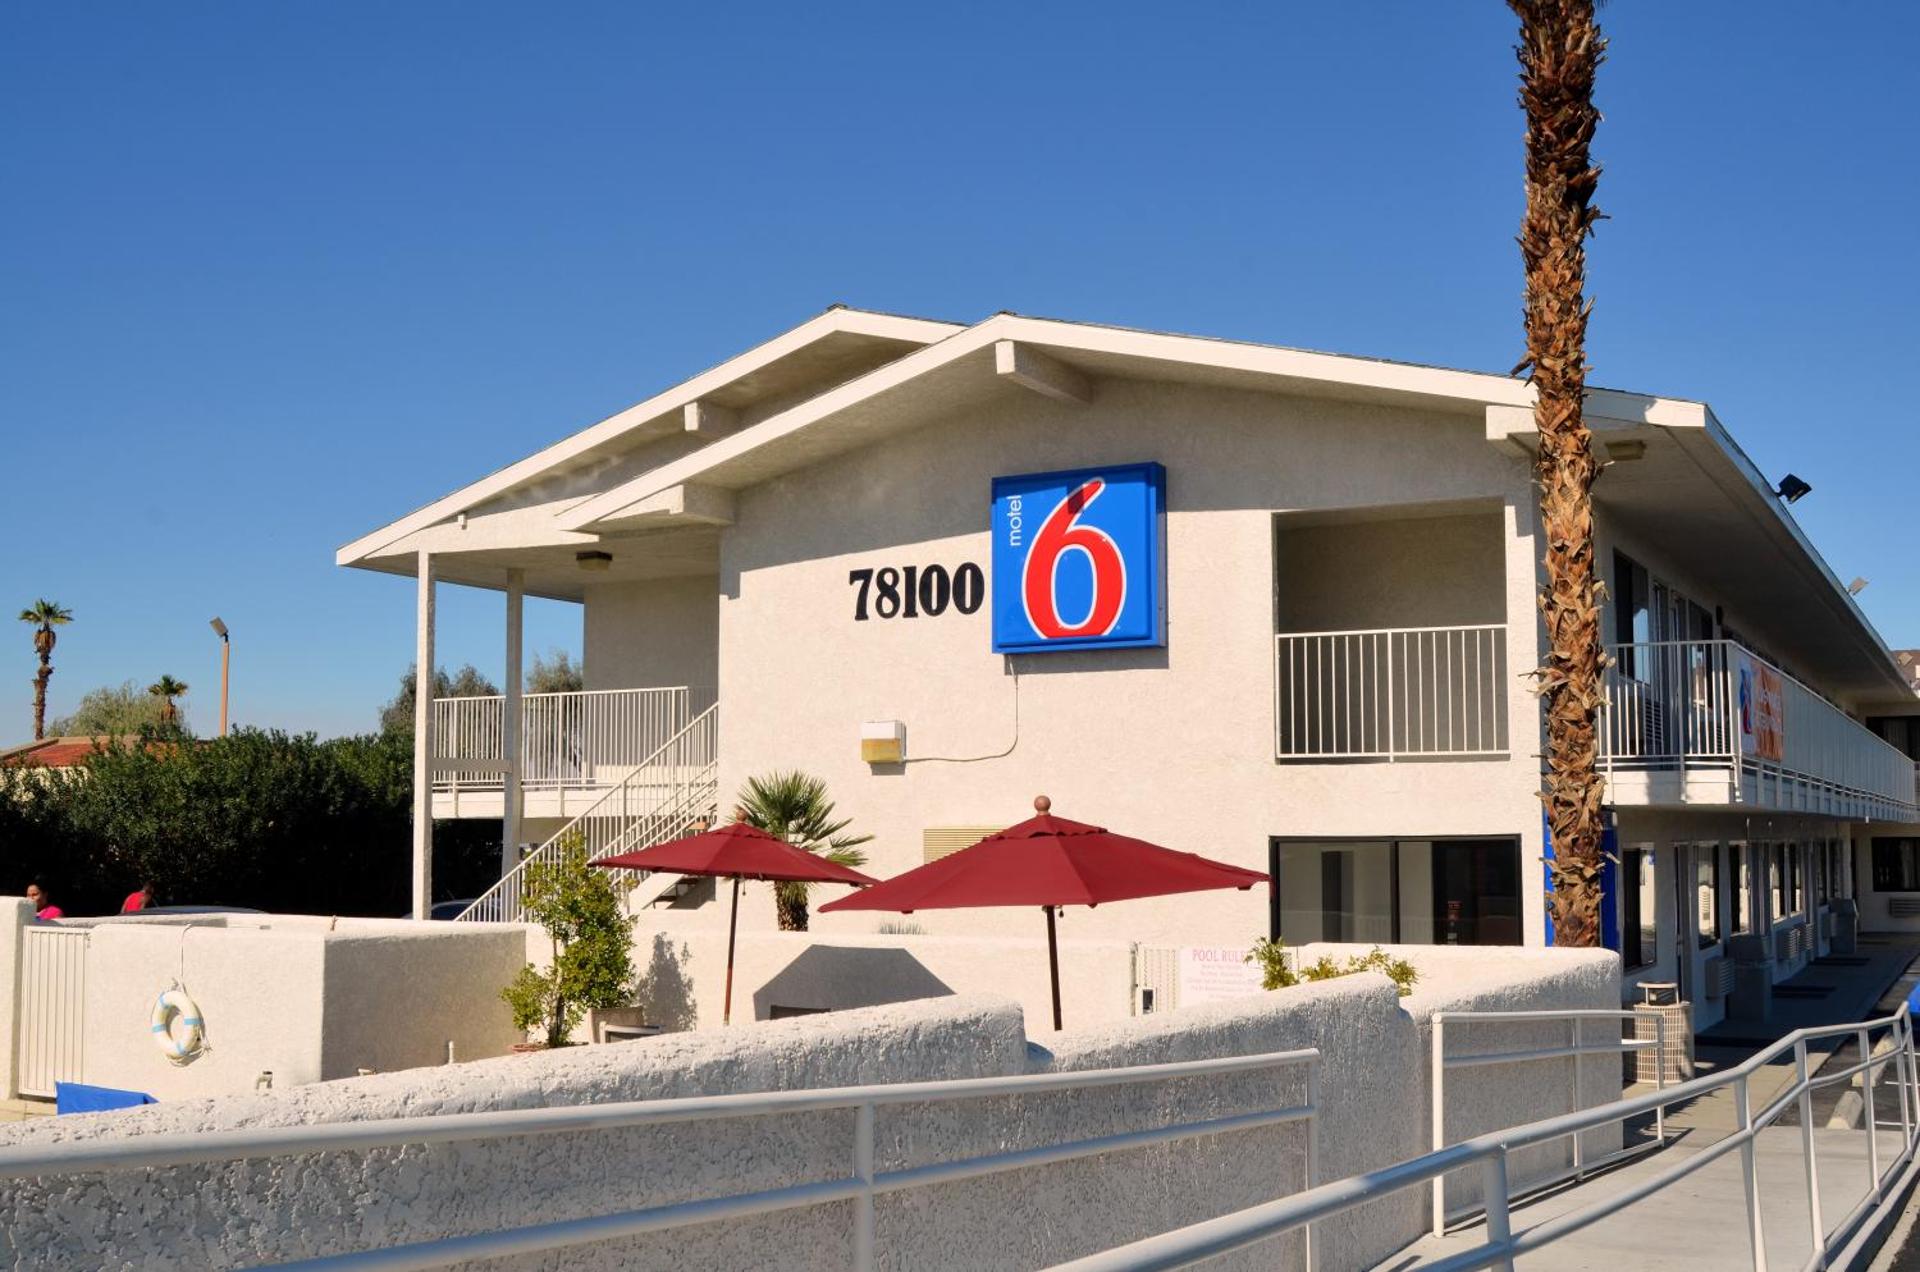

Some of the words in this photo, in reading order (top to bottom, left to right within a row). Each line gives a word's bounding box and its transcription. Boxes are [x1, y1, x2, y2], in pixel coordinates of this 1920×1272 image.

[1006, 495, 1022, 546] motel
[1022, 477, 1127, 639] 6
[849, 562, 985, 621] 78100
[1192, 949, 1219, 962] POOL
[1221, 949, 1248, 963] RULE
